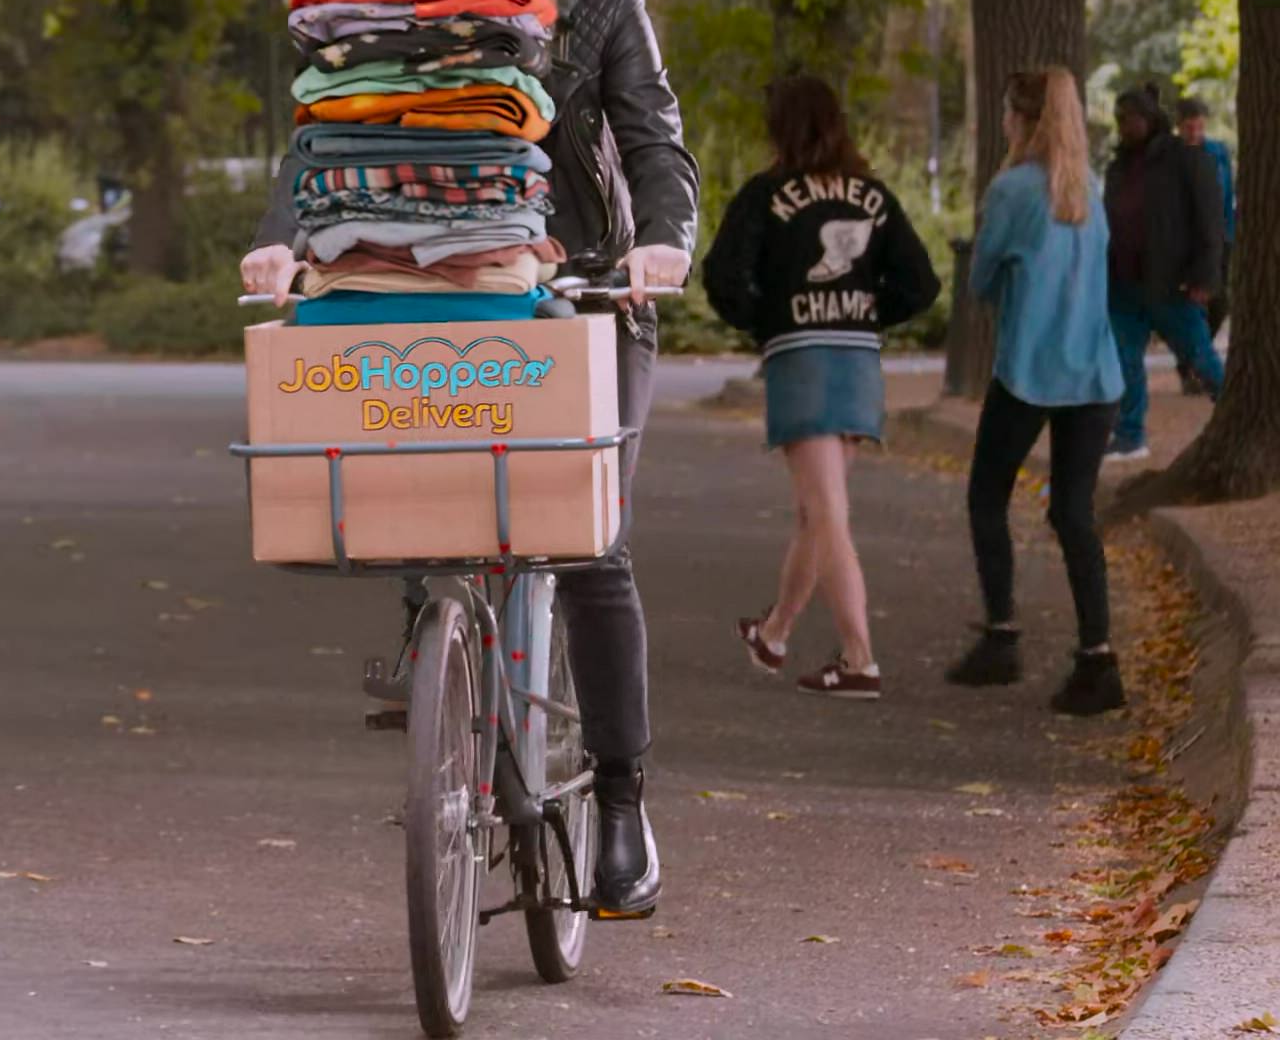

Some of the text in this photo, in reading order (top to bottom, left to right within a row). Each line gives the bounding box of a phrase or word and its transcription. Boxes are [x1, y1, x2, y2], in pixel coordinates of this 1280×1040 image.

[771, 174, 887, 227] KENNED
[792, 290, 877, 325] CHAMP
[278, 353, 521, 398] JobHopper
[362, 396, 514, 434] Delivery
